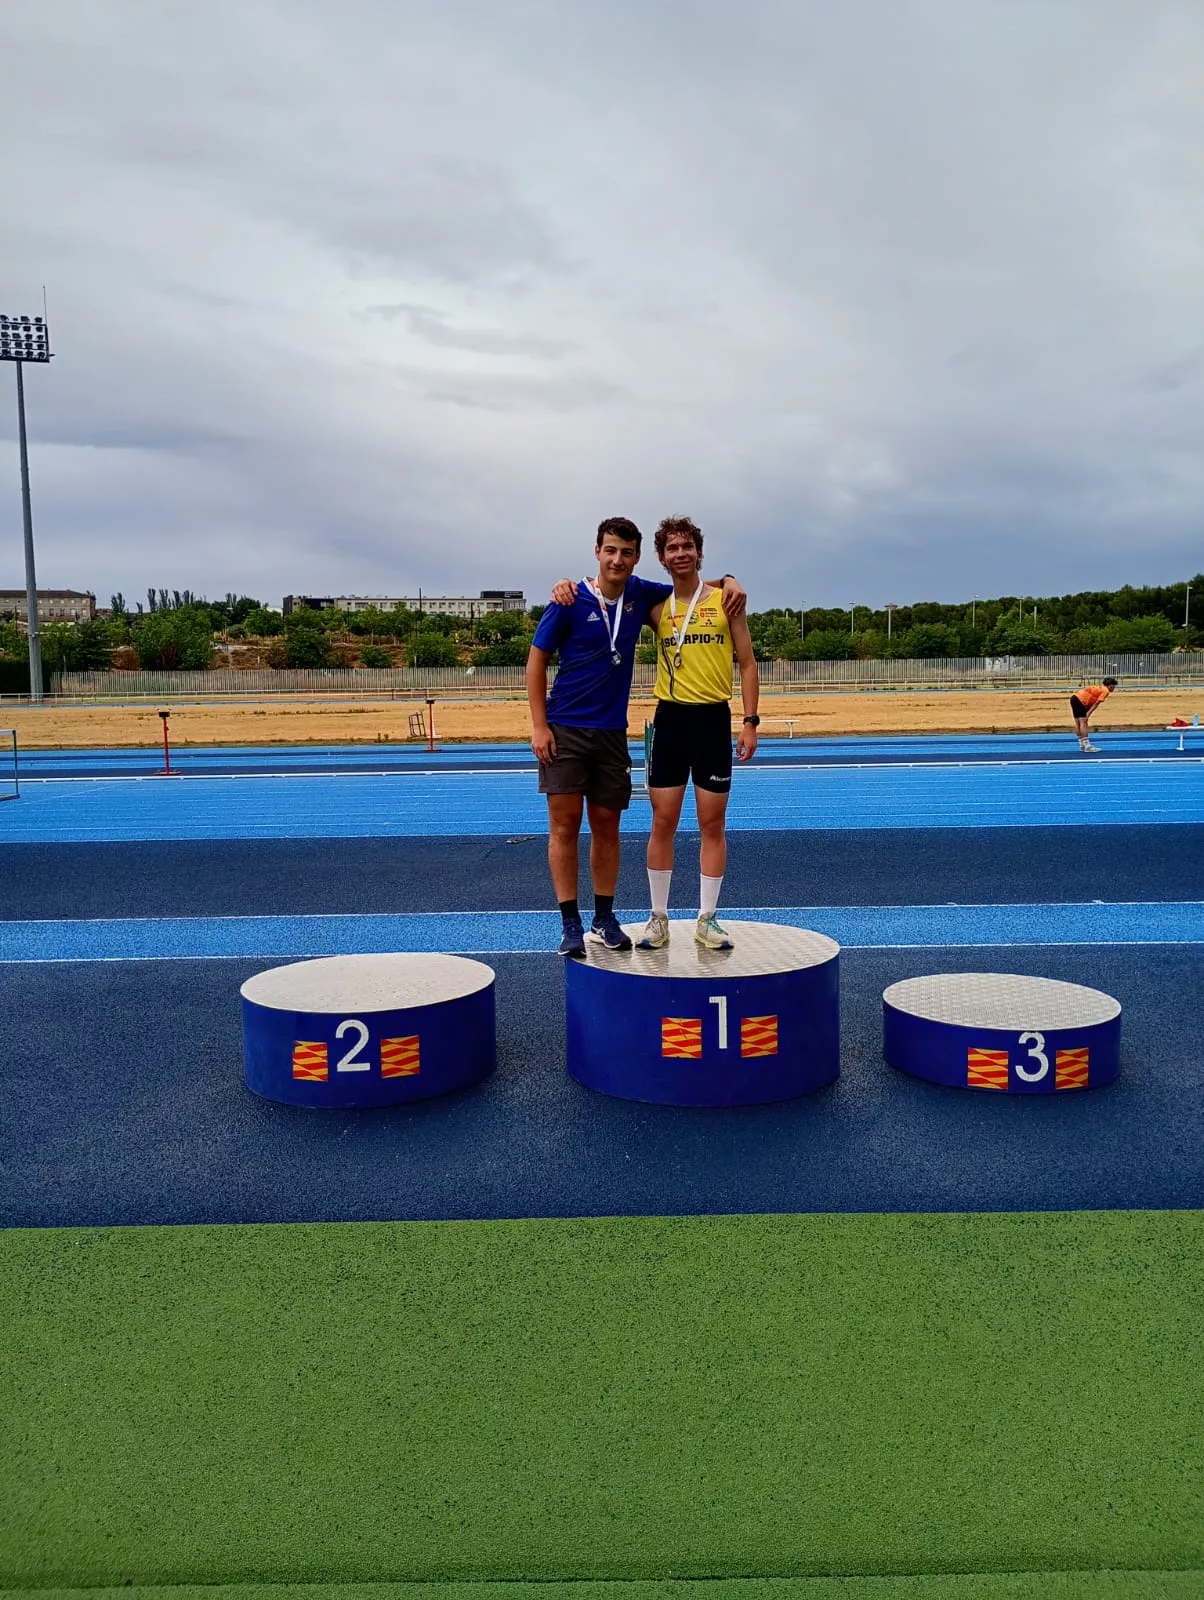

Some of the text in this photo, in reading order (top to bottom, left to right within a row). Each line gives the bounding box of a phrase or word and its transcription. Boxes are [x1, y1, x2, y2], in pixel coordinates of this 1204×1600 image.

[664, 633, 724, 648] SCRPIO-71
[335, 1019, 371, 1072] 2
[709, 995, 727, 1049] 1
[1015, 1031, 1049, 1082] 3
